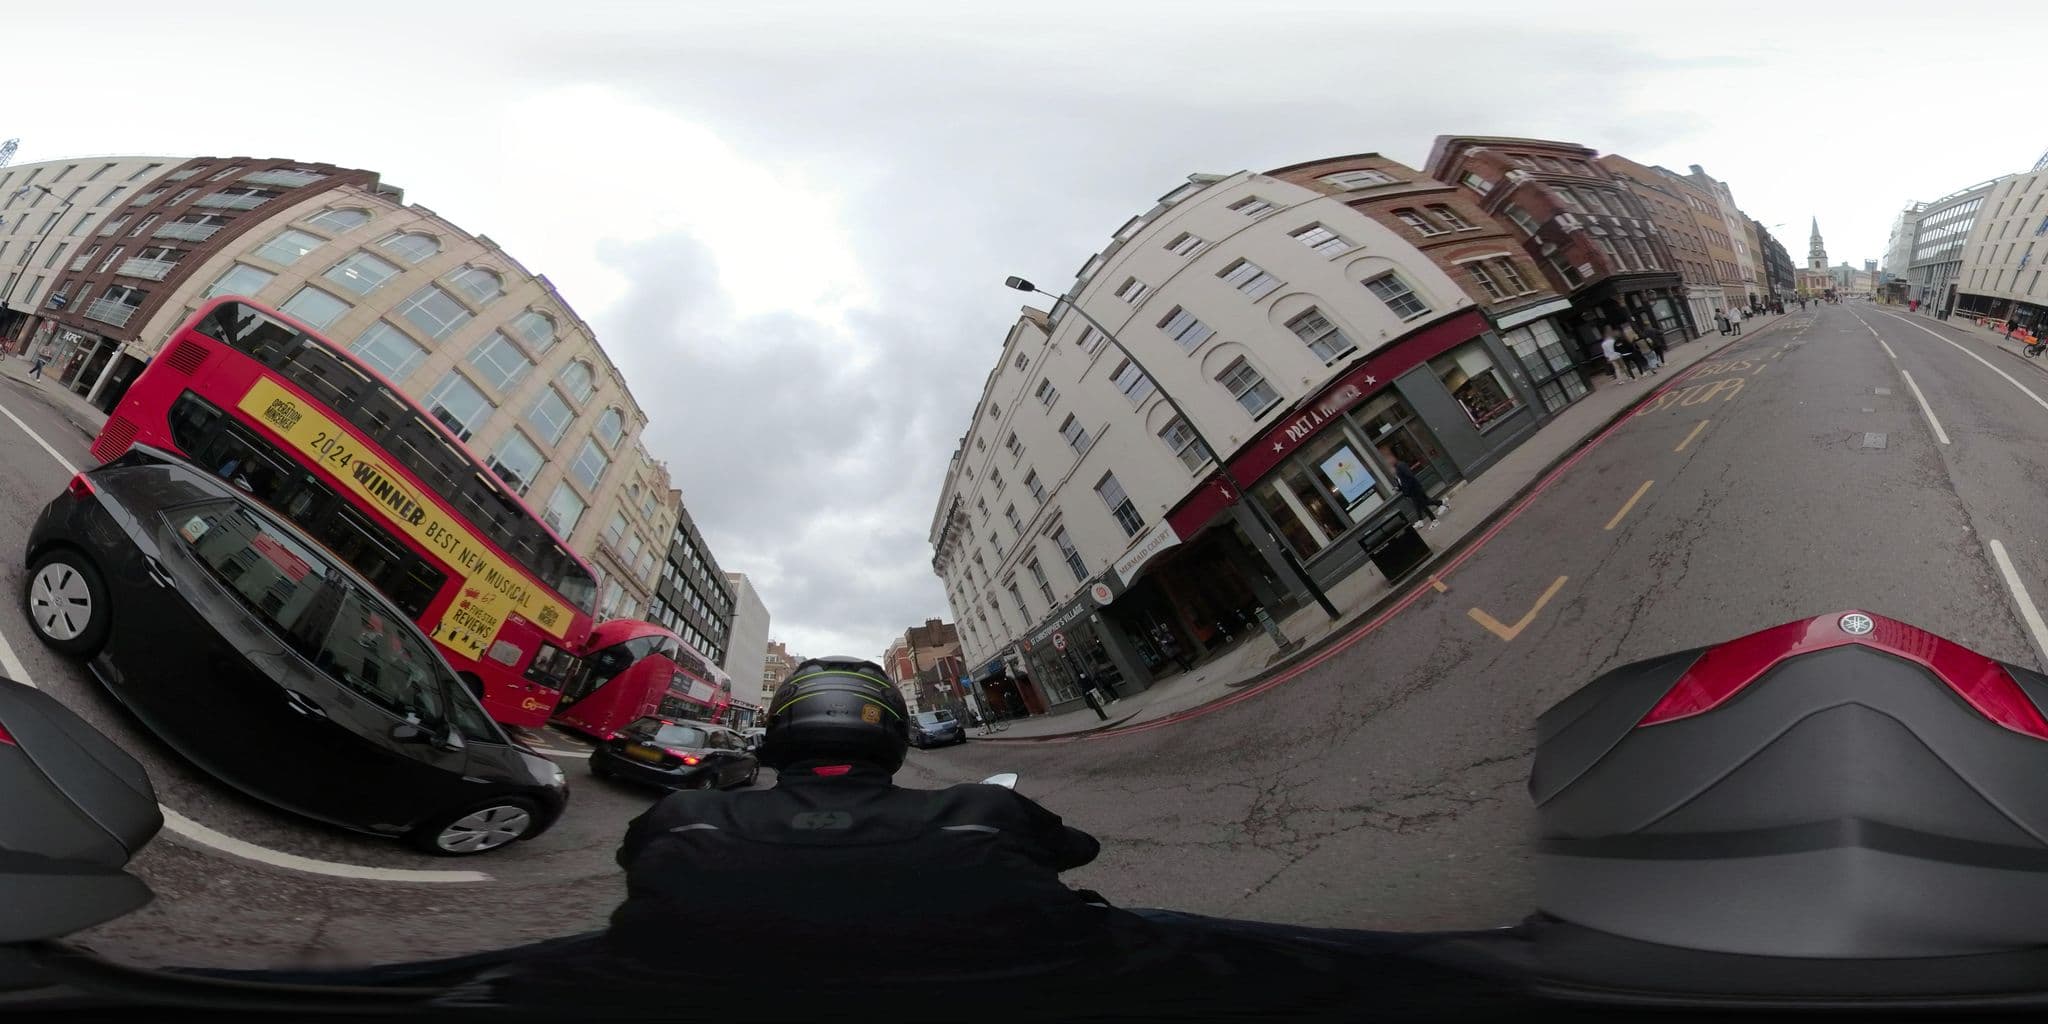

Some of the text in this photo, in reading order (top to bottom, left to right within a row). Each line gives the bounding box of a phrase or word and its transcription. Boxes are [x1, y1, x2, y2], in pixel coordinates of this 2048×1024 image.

[63, 331, 82, 343] KFC
[271, 398, 302, 423] OPERATION
[1635, 378, 1745, 416] STOP
[1285, 410, 1323, 442] PRET A
[311, 432, 532, 608] 2024 WINNER BEST NEW MUSICAL
[1120, 530, 1170, 574] MERMAID COURT
[453, 609, 492, 639] REVIEWS
[1063, 603, 1084, 623] VILLAGE
